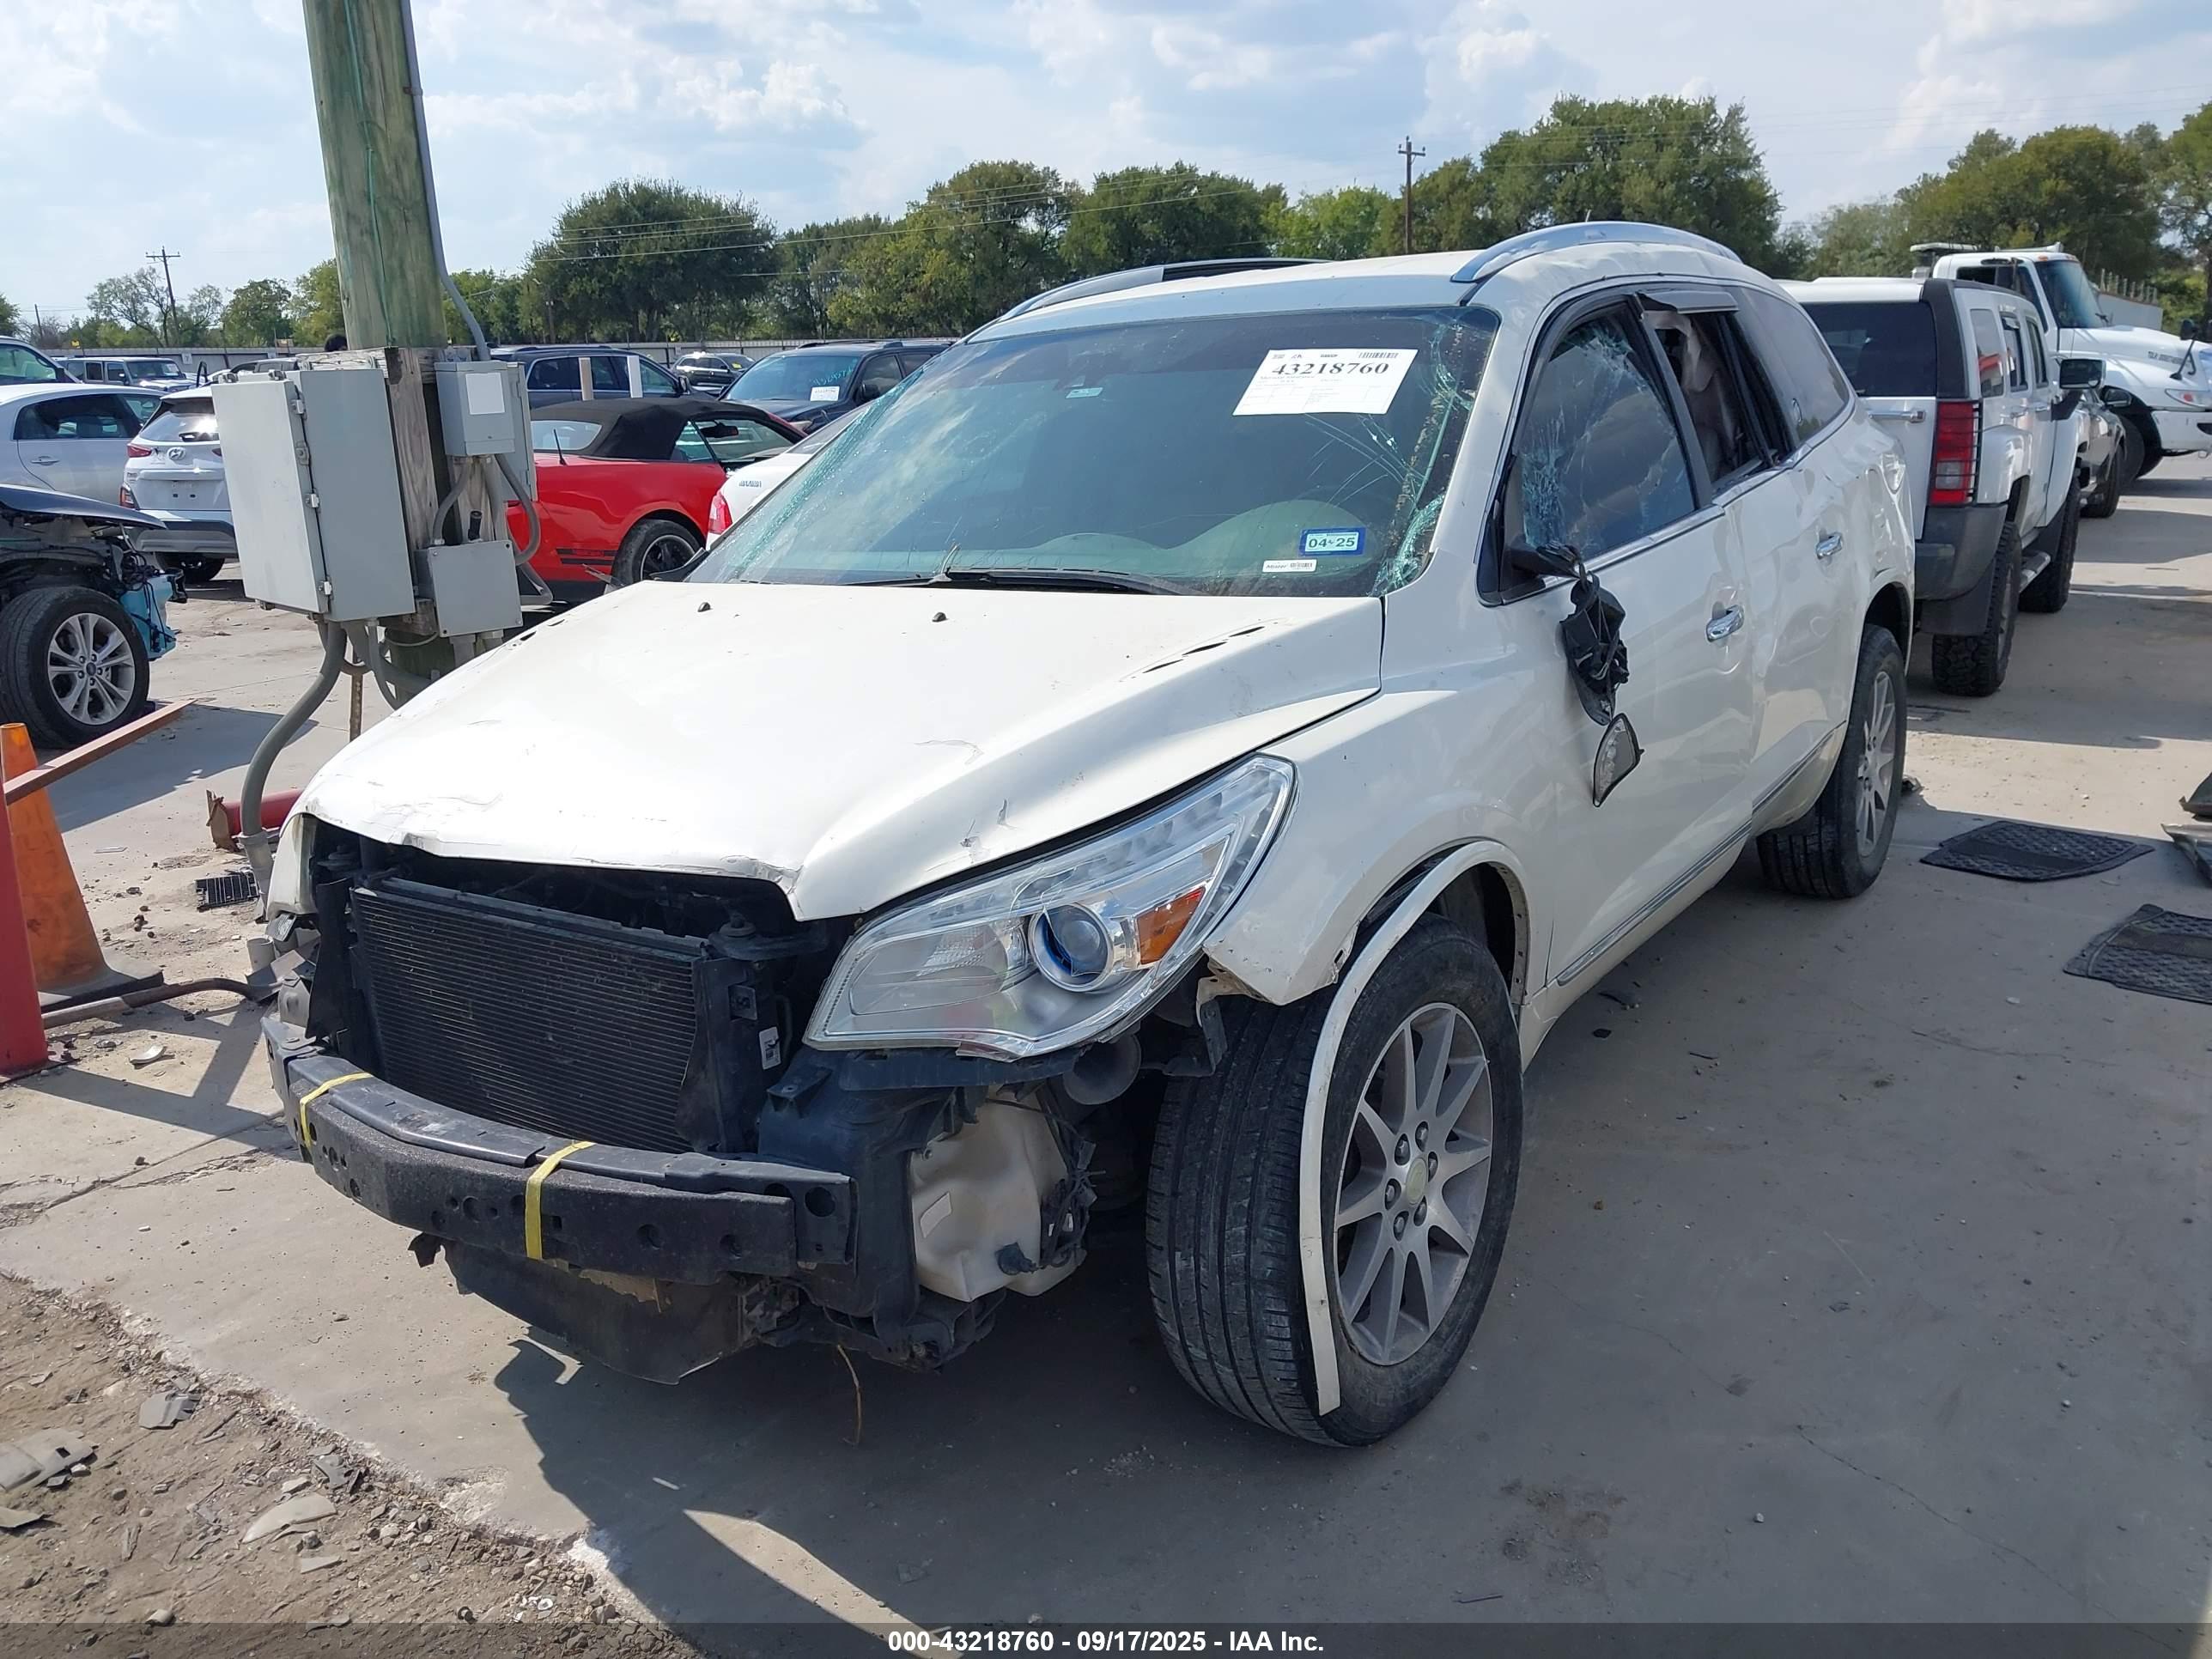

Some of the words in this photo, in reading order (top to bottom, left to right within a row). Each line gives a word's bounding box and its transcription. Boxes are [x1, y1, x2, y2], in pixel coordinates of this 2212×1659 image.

[1272, 362, 1389, 375] 43218760
[1308, 538, 1328, 549] 04
[1335, 538, 1356, 548] 25
